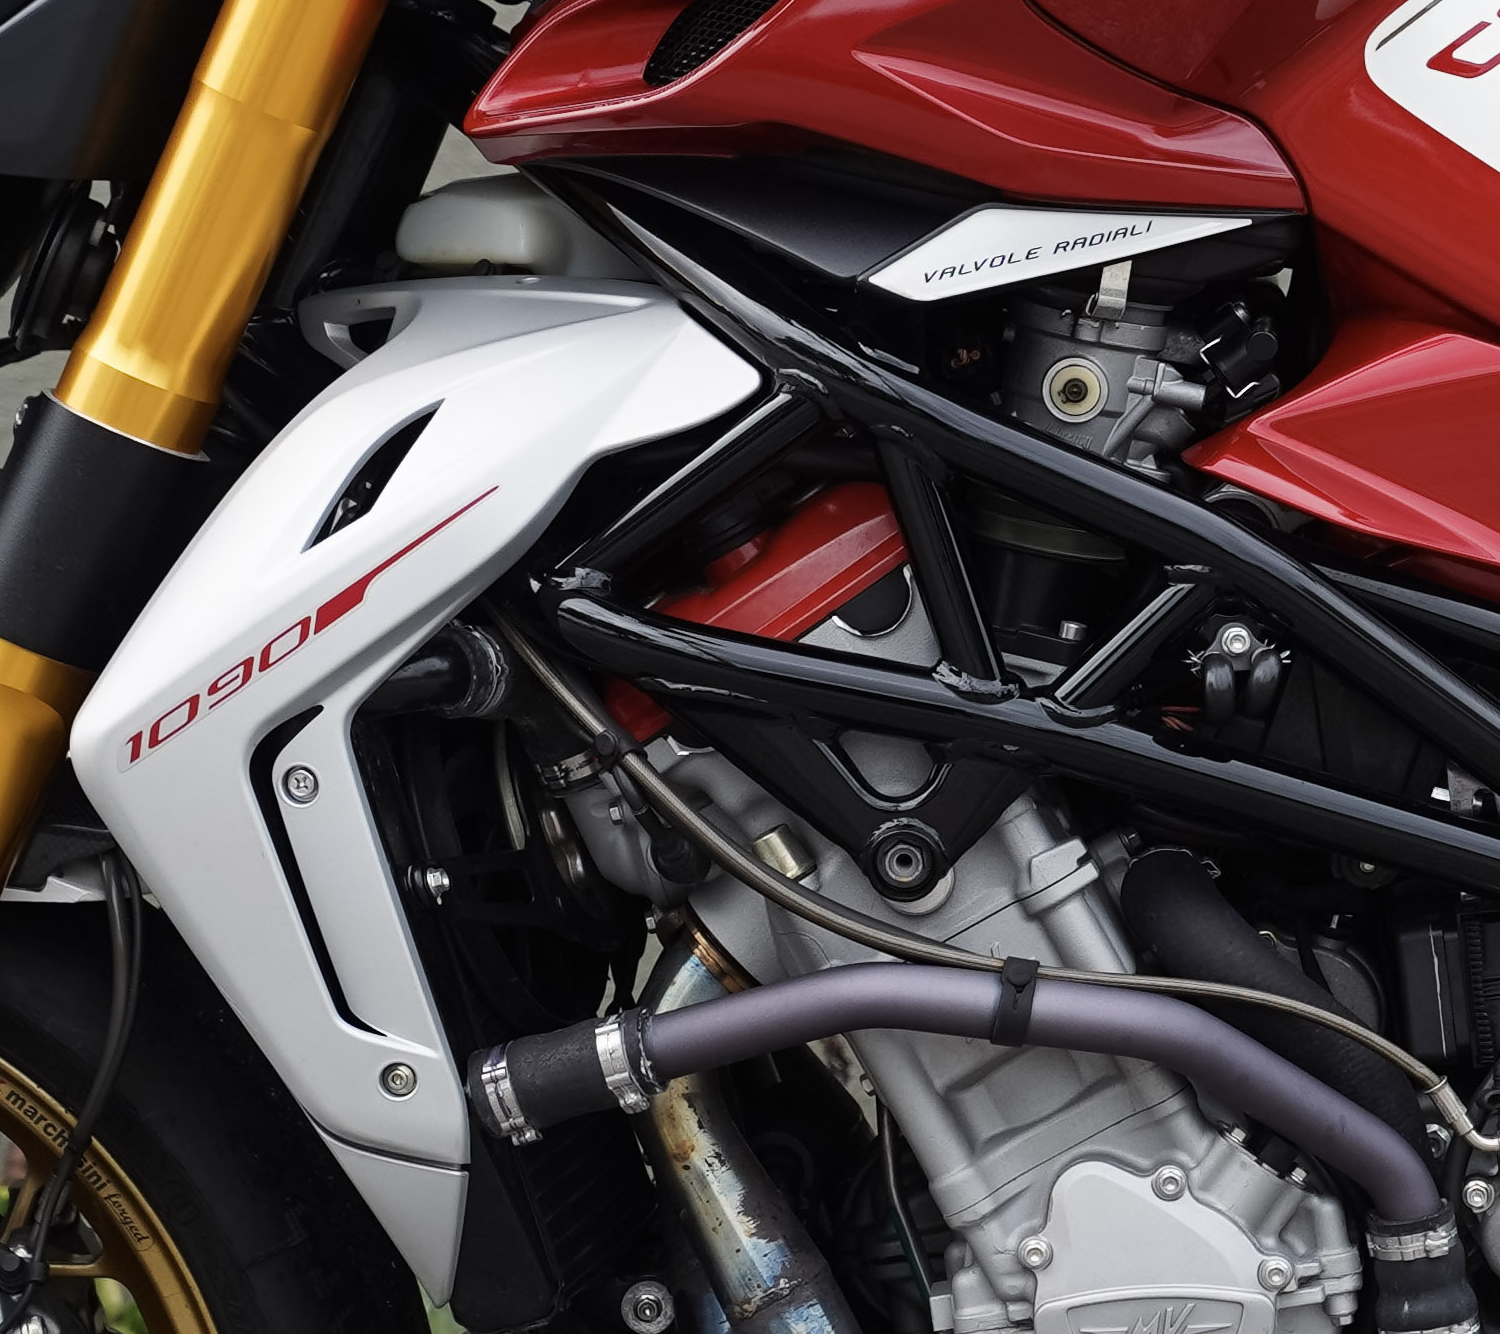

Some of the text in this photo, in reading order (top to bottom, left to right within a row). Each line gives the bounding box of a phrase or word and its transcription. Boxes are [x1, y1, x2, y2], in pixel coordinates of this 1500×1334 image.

[923, 220, 1153, 283] VALVOLE RADIALI
[125, 617, 311, 761] 1090
[103, 1192, 148, 1246] forged
